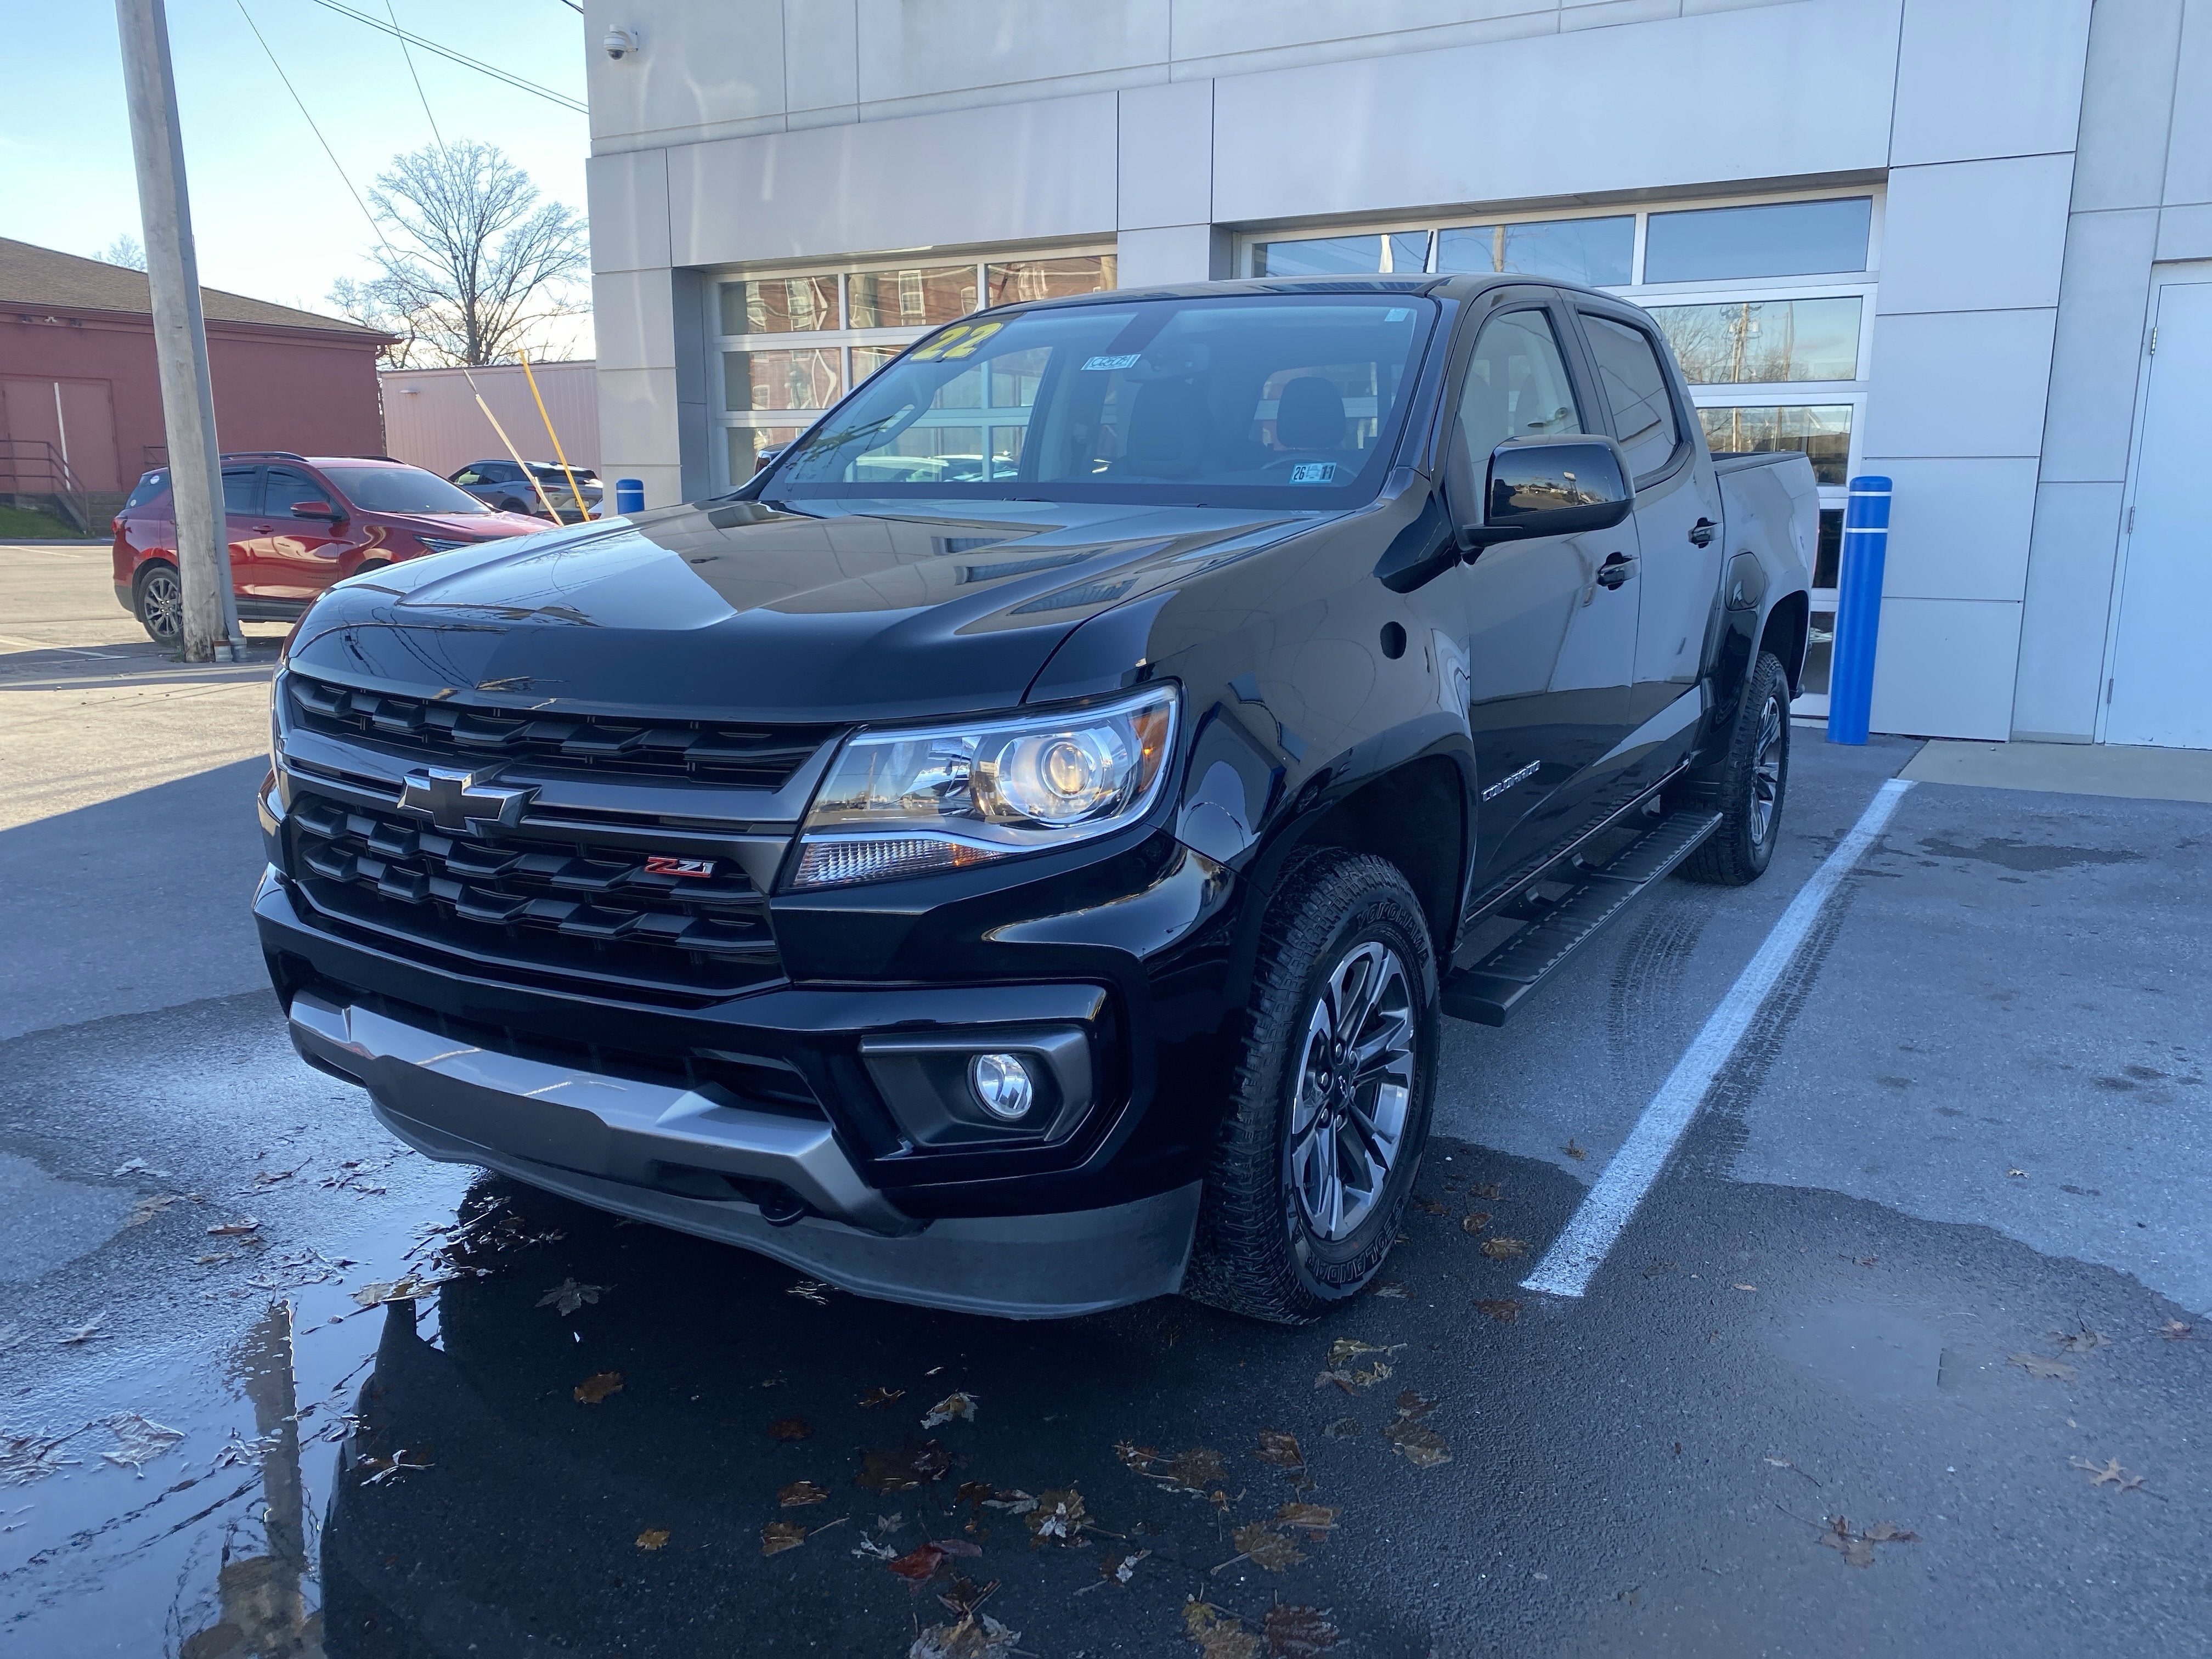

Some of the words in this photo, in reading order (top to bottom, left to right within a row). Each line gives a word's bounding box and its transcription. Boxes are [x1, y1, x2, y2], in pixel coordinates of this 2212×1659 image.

[910, 323, 1003, 362] 22
[1294, 466, 1306, 480] 26
[1321, 465, 1334, 479] 11
[644, 856, 714, 878] Z71
[1357, 901, 1429, 969] YOKOHAMA
